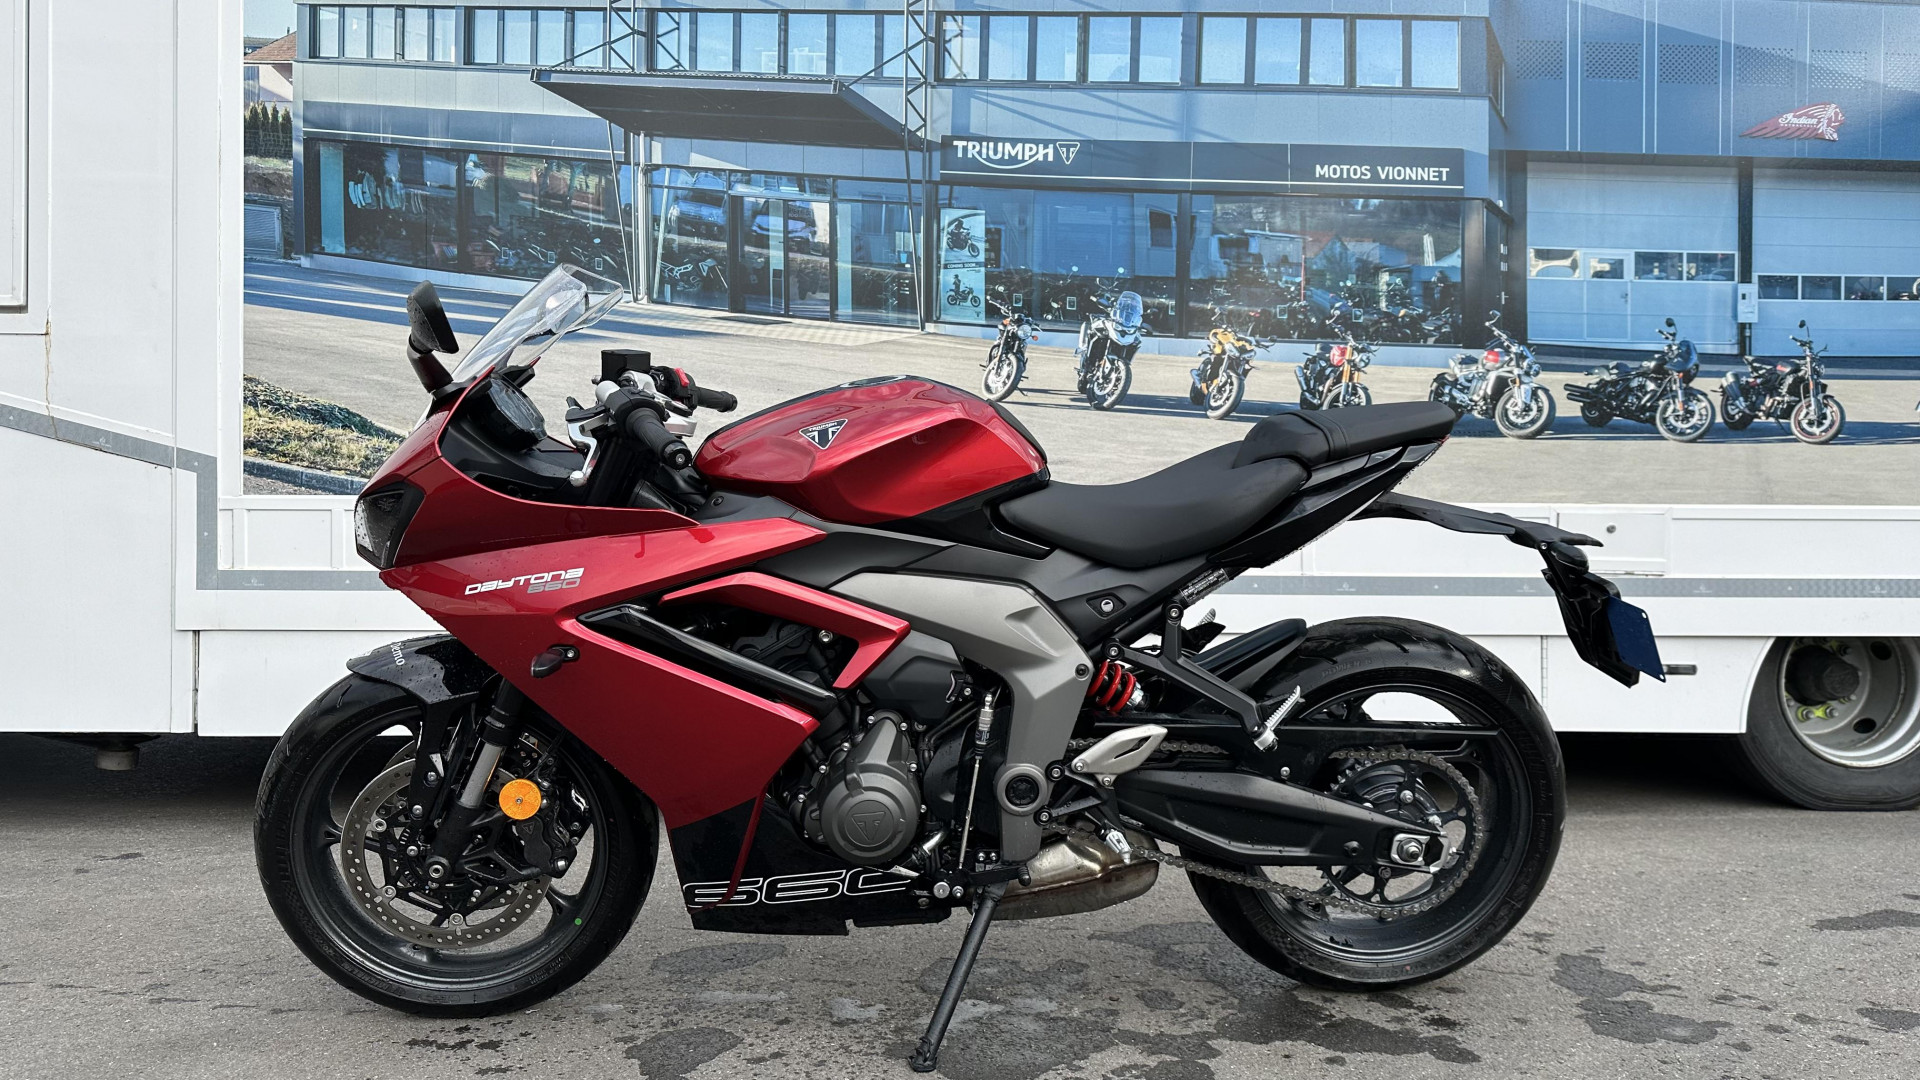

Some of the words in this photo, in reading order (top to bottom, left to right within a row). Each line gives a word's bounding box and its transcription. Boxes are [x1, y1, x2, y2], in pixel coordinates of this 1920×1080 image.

[1778, 112, 1818, 125] Indian
[952, 140, 1054, 169] TRIUMPH
[1315, 164, 1371, 179] MOTOS
[1377, 165, 1450, 181] VIONNET
[808, 421, 838, 432] TRIUMPH
[527, 578, 581, 594] 660
